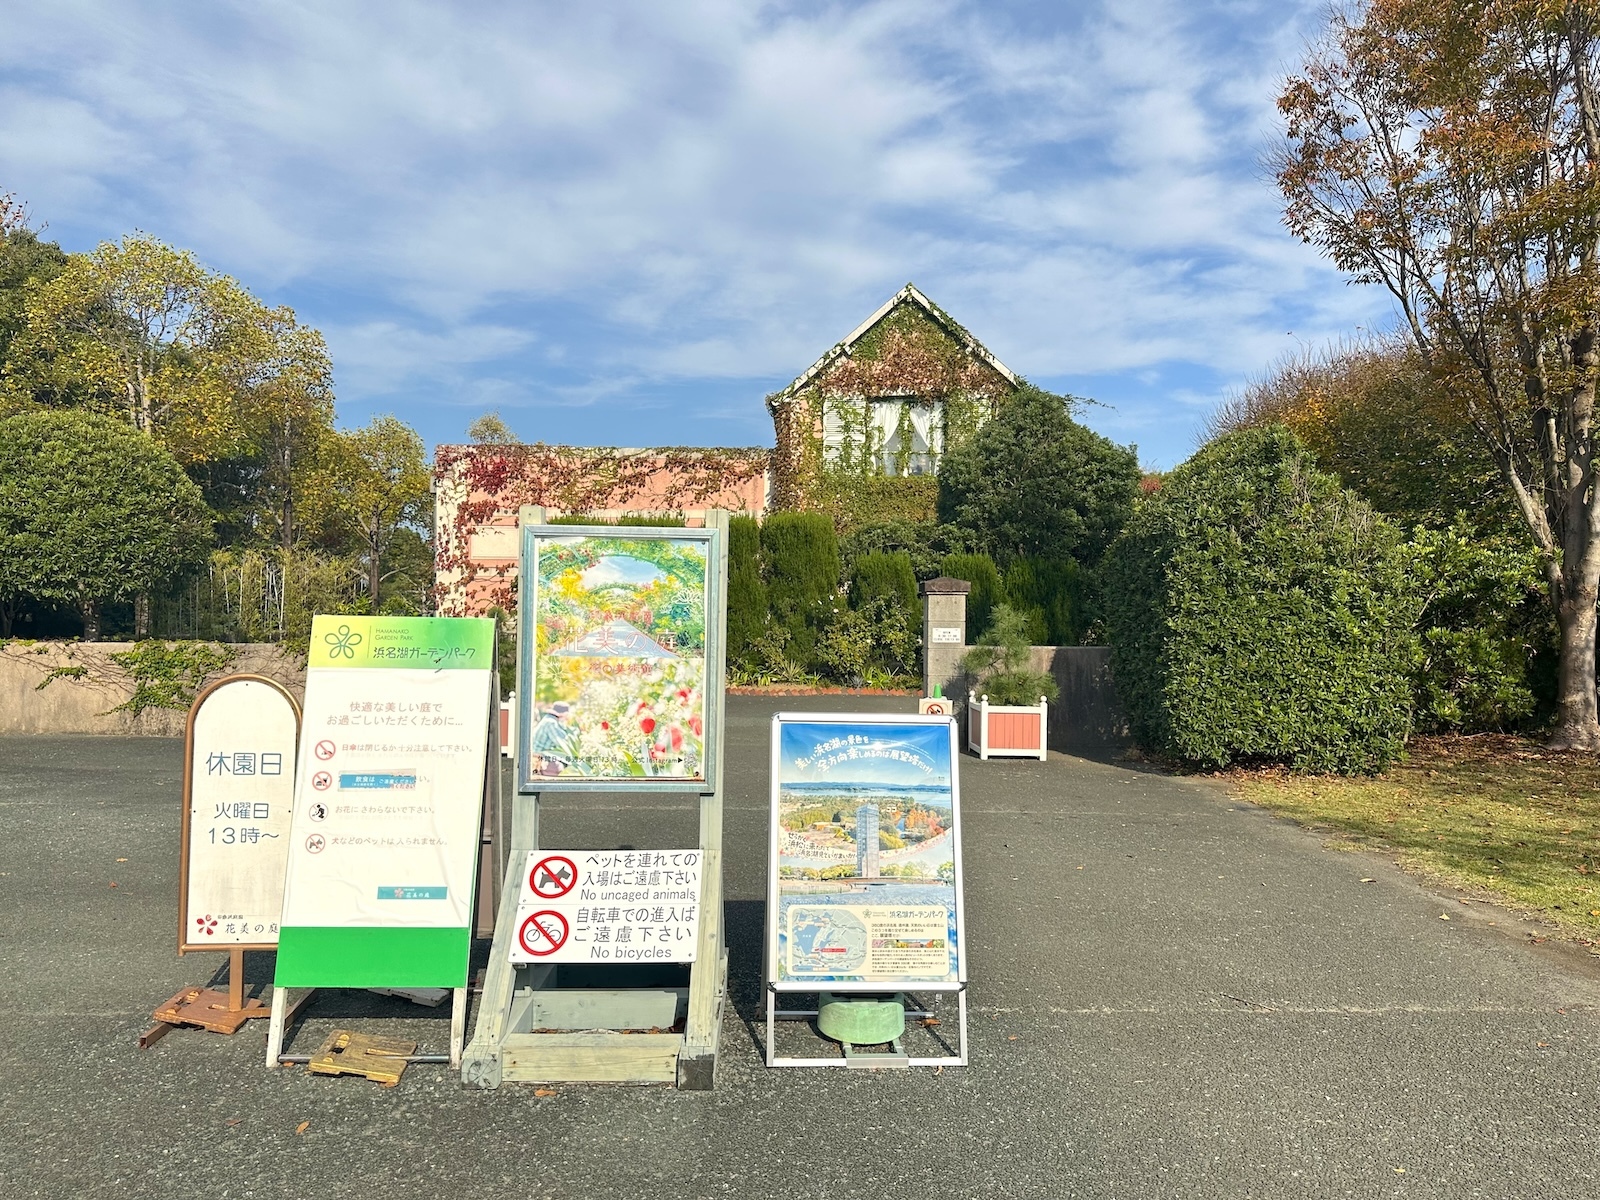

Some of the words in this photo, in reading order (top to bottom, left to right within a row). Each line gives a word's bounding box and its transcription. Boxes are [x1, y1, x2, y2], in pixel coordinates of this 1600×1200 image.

[373, 647, 476, 659] 浜名湖ガーデンパーク
[349, 702, 442, 713] 快適な美しい庭で
[795, 735, 869, 770] 美しい浜名湖の景色を
[205, 752, 282, 776] 休園日
[214, 802, 269, 819] 火曜日
[586, 853, 697, 869] ペットを連れての
[582, 870, 696, 887] 入場はご遠慮下さい
[580, 889, 597, 901] No
[601, 889, 649, 902] uncaged
[653, 889, 696, 901] animals
[889, 911, 944, 919] 浜名湖ガーデンパーク
[225, 922, 279, 934] 花美の庭
[574, 926, 692, 943] ご遠慮下さい
[590, 946, 610, 959] No
[615, 946, 672, 960] bicycles
